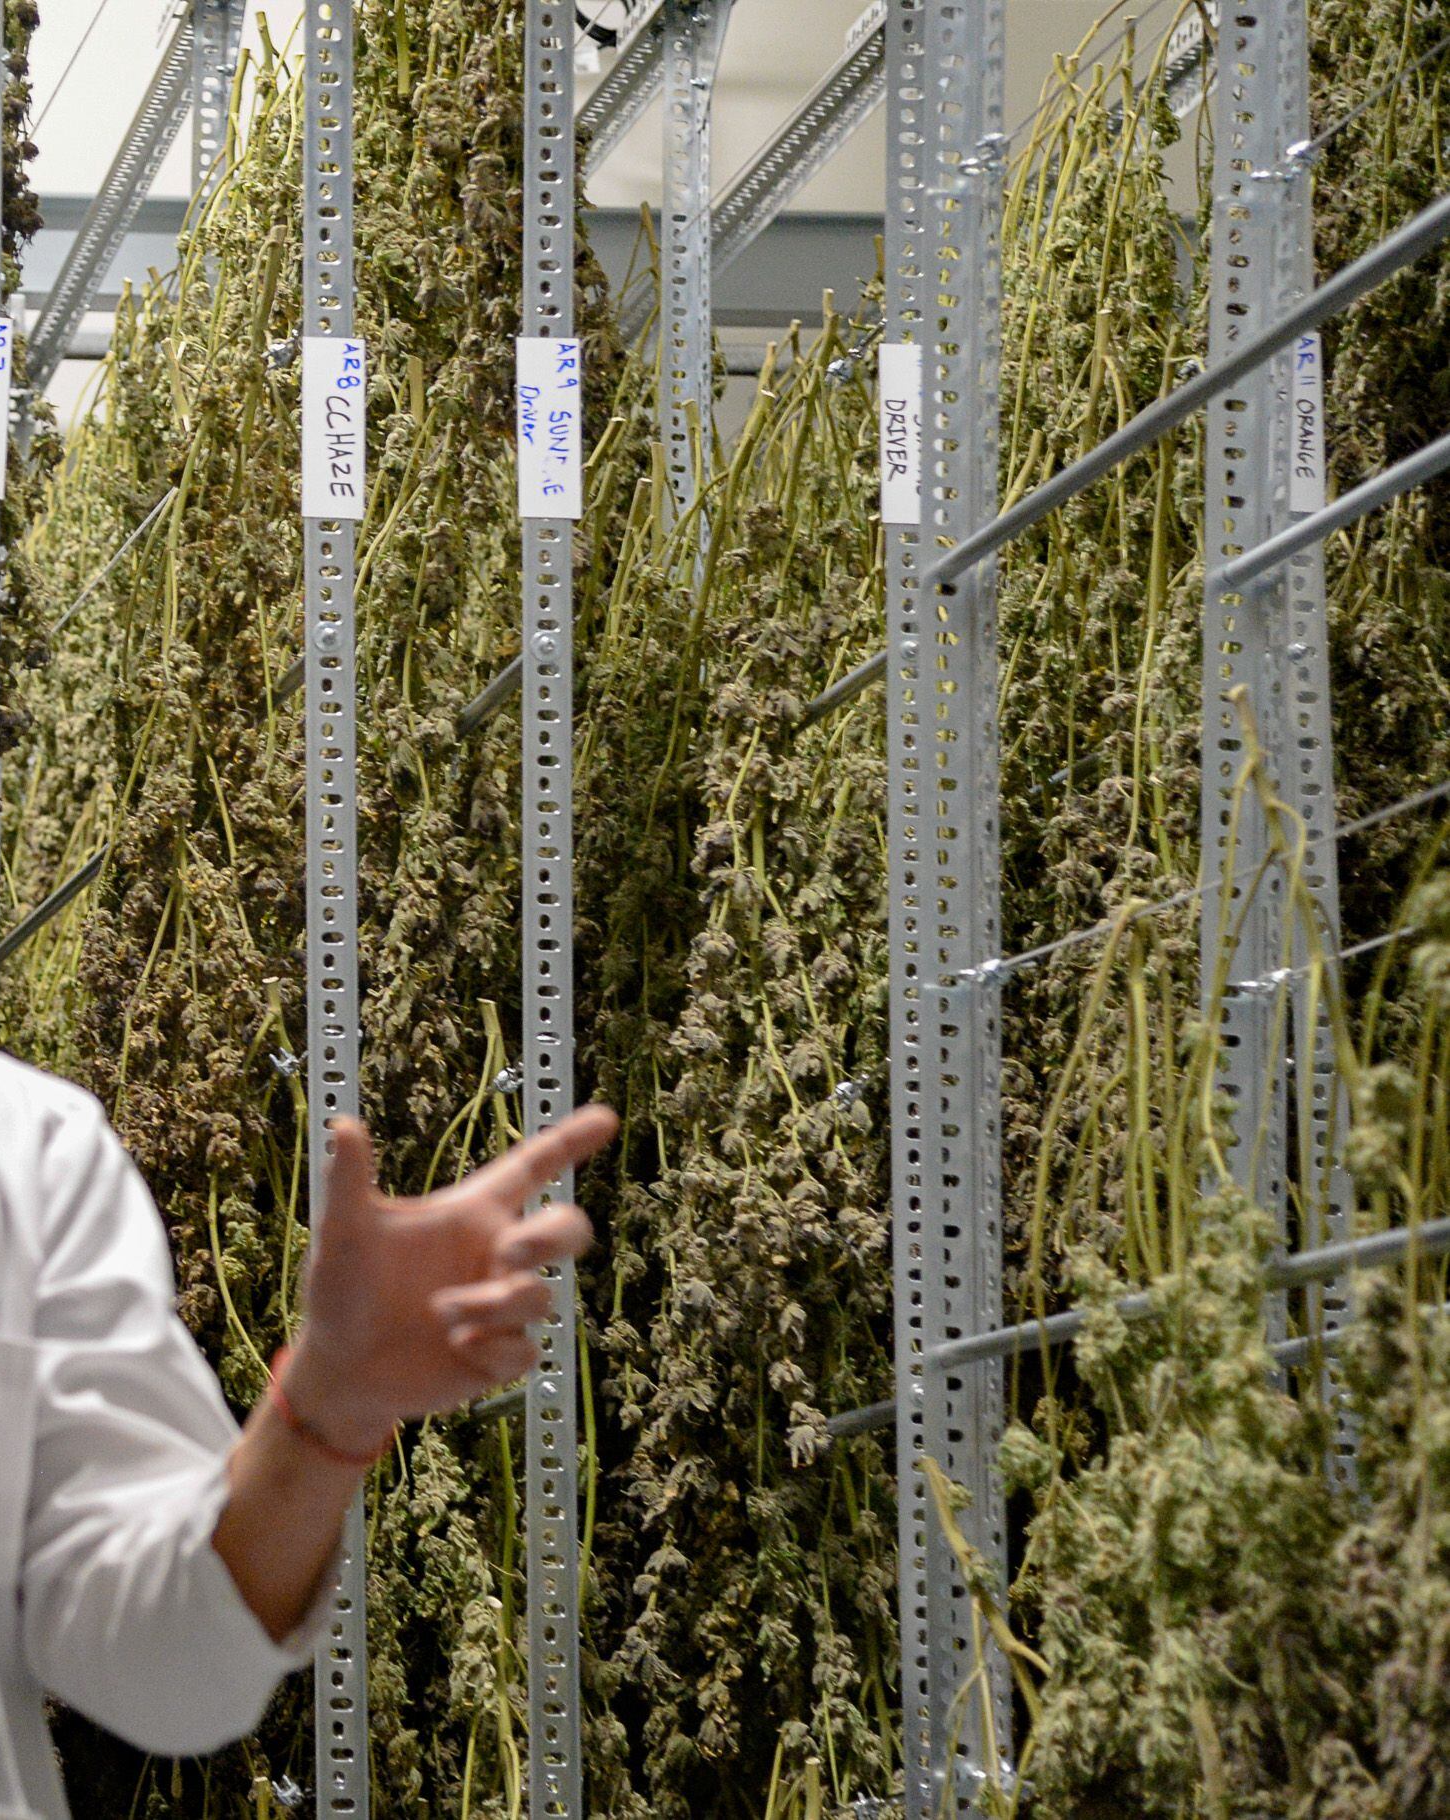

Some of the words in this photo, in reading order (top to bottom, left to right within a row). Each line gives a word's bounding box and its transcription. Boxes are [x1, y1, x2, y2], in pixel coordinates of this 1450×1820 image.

[519, 385, 541, 445] Driver
[885, 399, 907, 482] DRIVER
[1295, 398, 1316, 479] ORANGE
